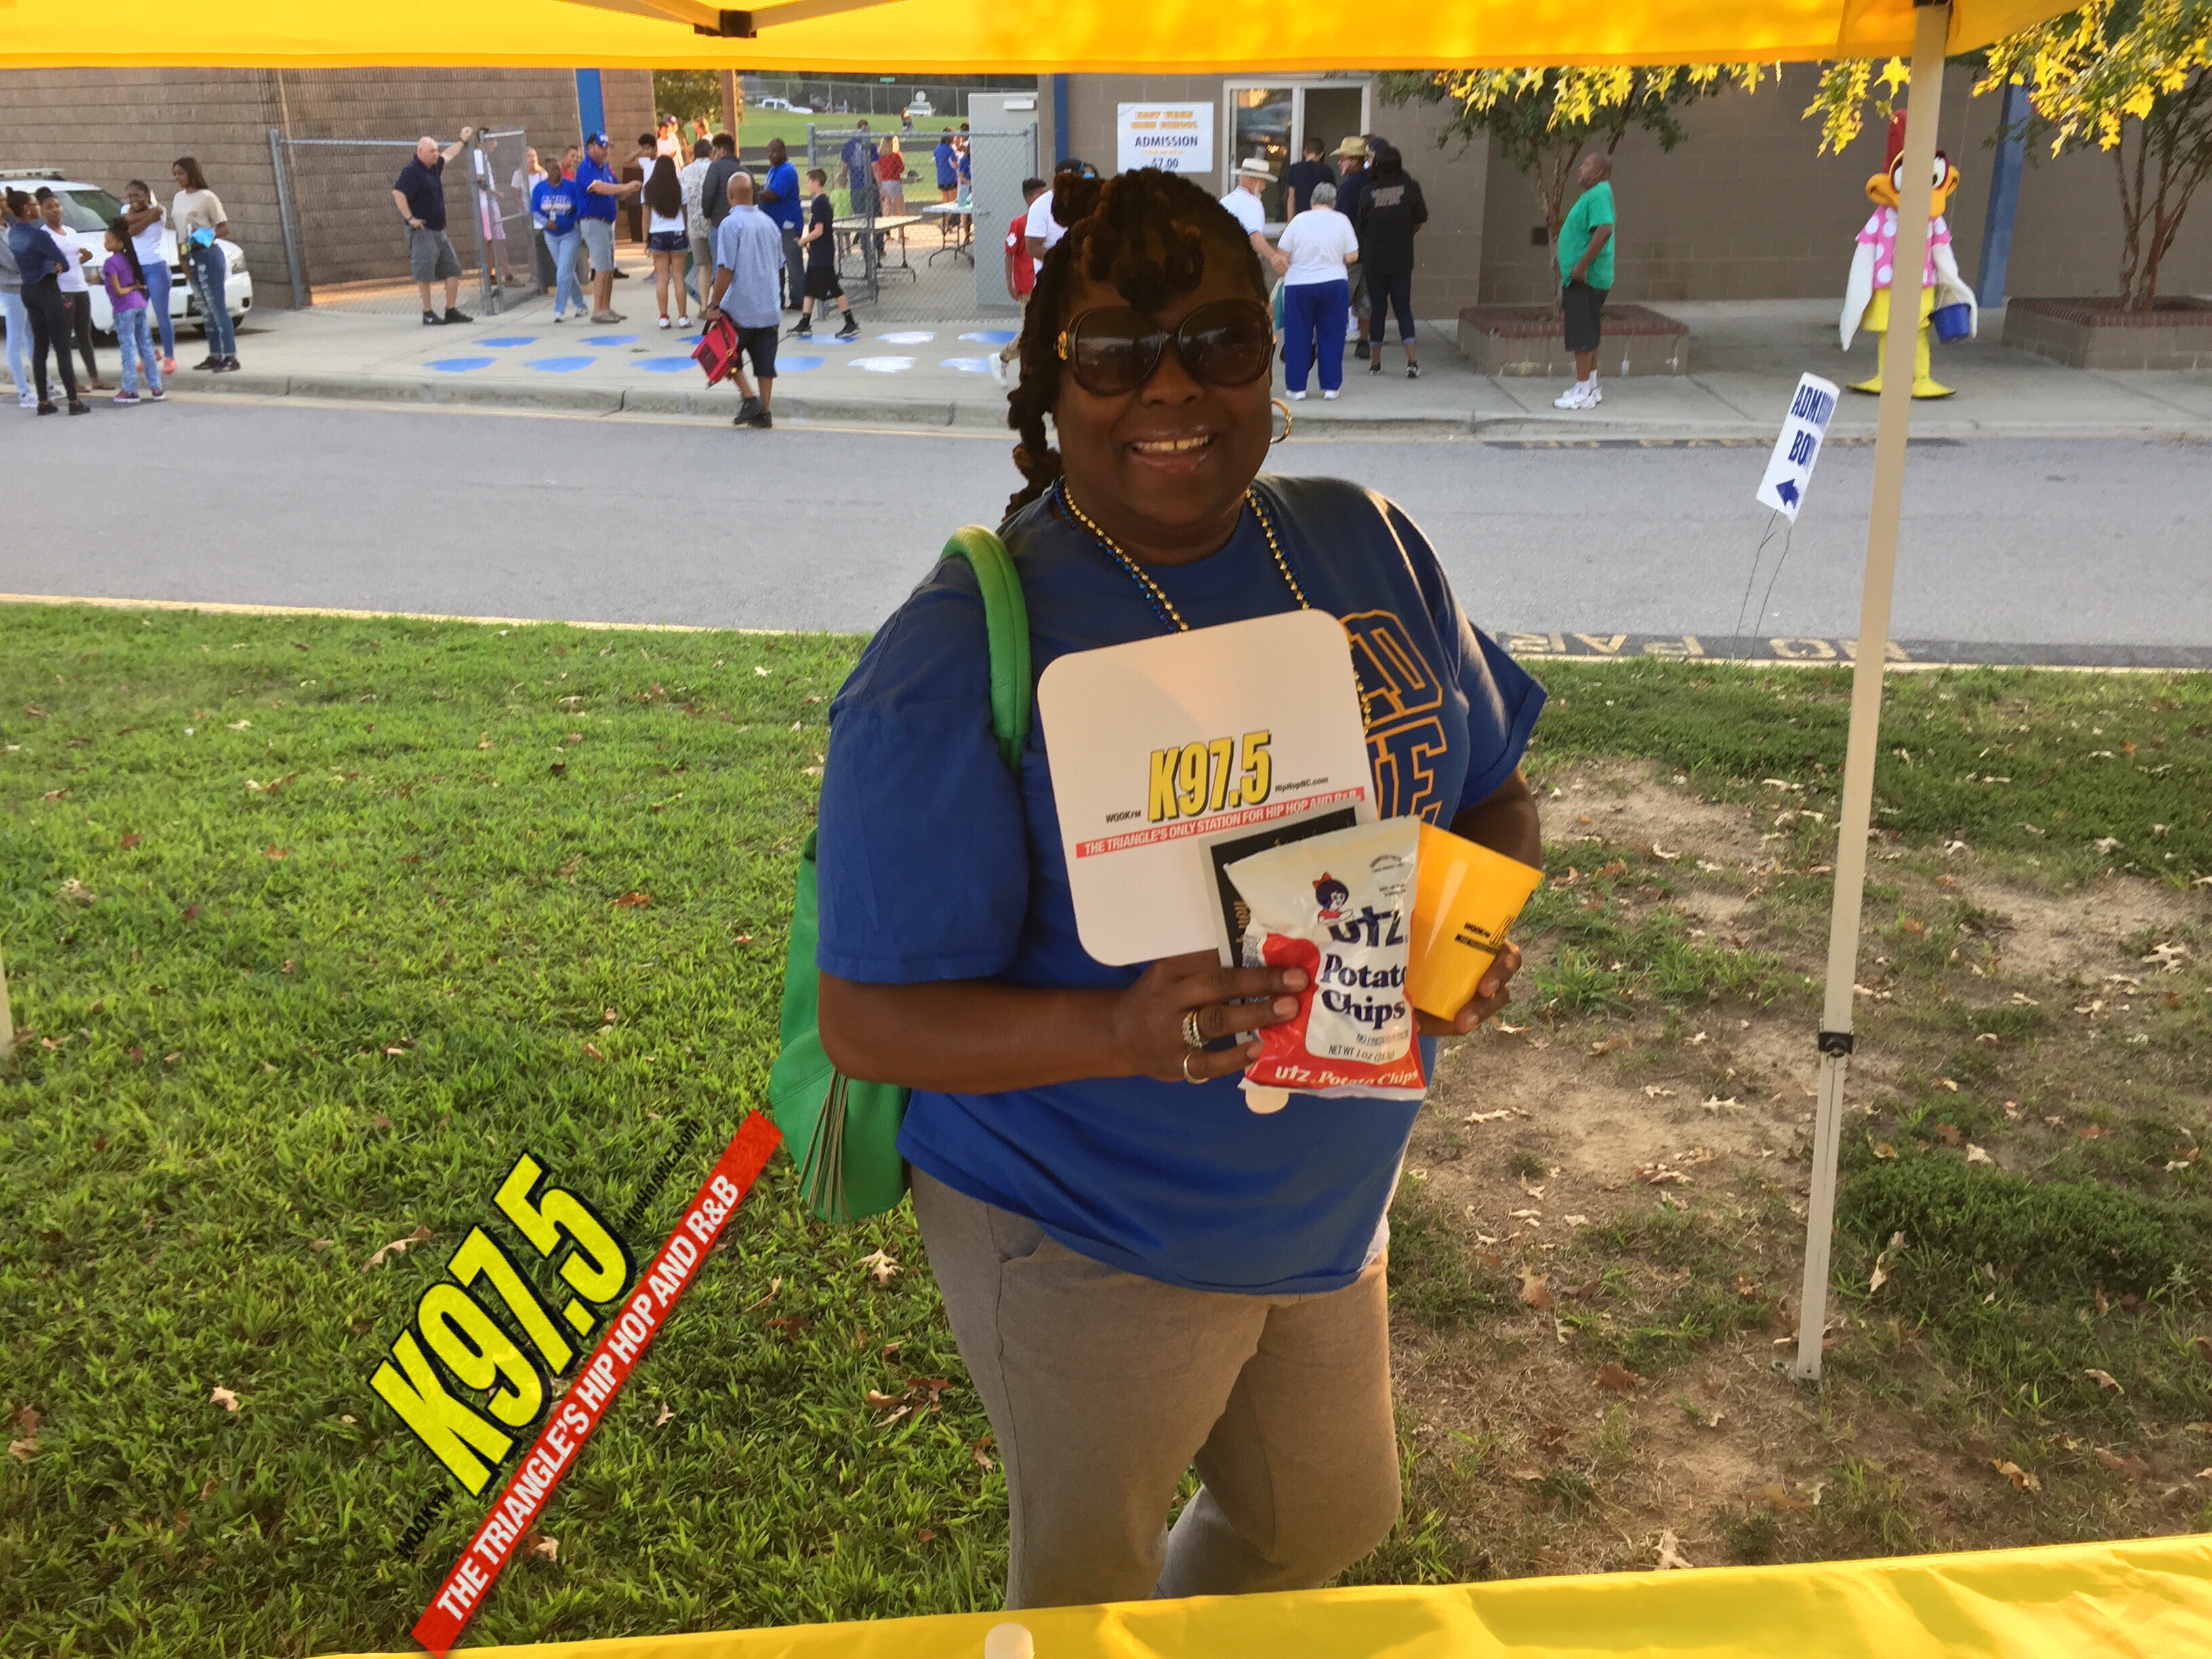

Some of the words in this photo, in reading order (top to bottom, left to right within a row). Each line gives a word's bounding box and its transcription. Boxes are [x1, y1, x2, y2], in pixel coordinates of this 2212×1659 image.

[1134, 136, 1198, 147] ADMISSION
[1148, 729, 1272, 822] K97.5
[1084, 841, 1105, 855] THE
[1106, 826, 1168, 850] TRIANGLE'S
[1169, 822, 1198, 838] ONLY
[1197, 814, 1241, 833] STATION
[1242, 808, 1265, 824] FOR
[1266, 804, 1285, 819] HIP
[1286, 800, 1308, 815] HOP
[1309, 794, 1333, 808] AND
[1322, 989, 1406, 1030] Chips
